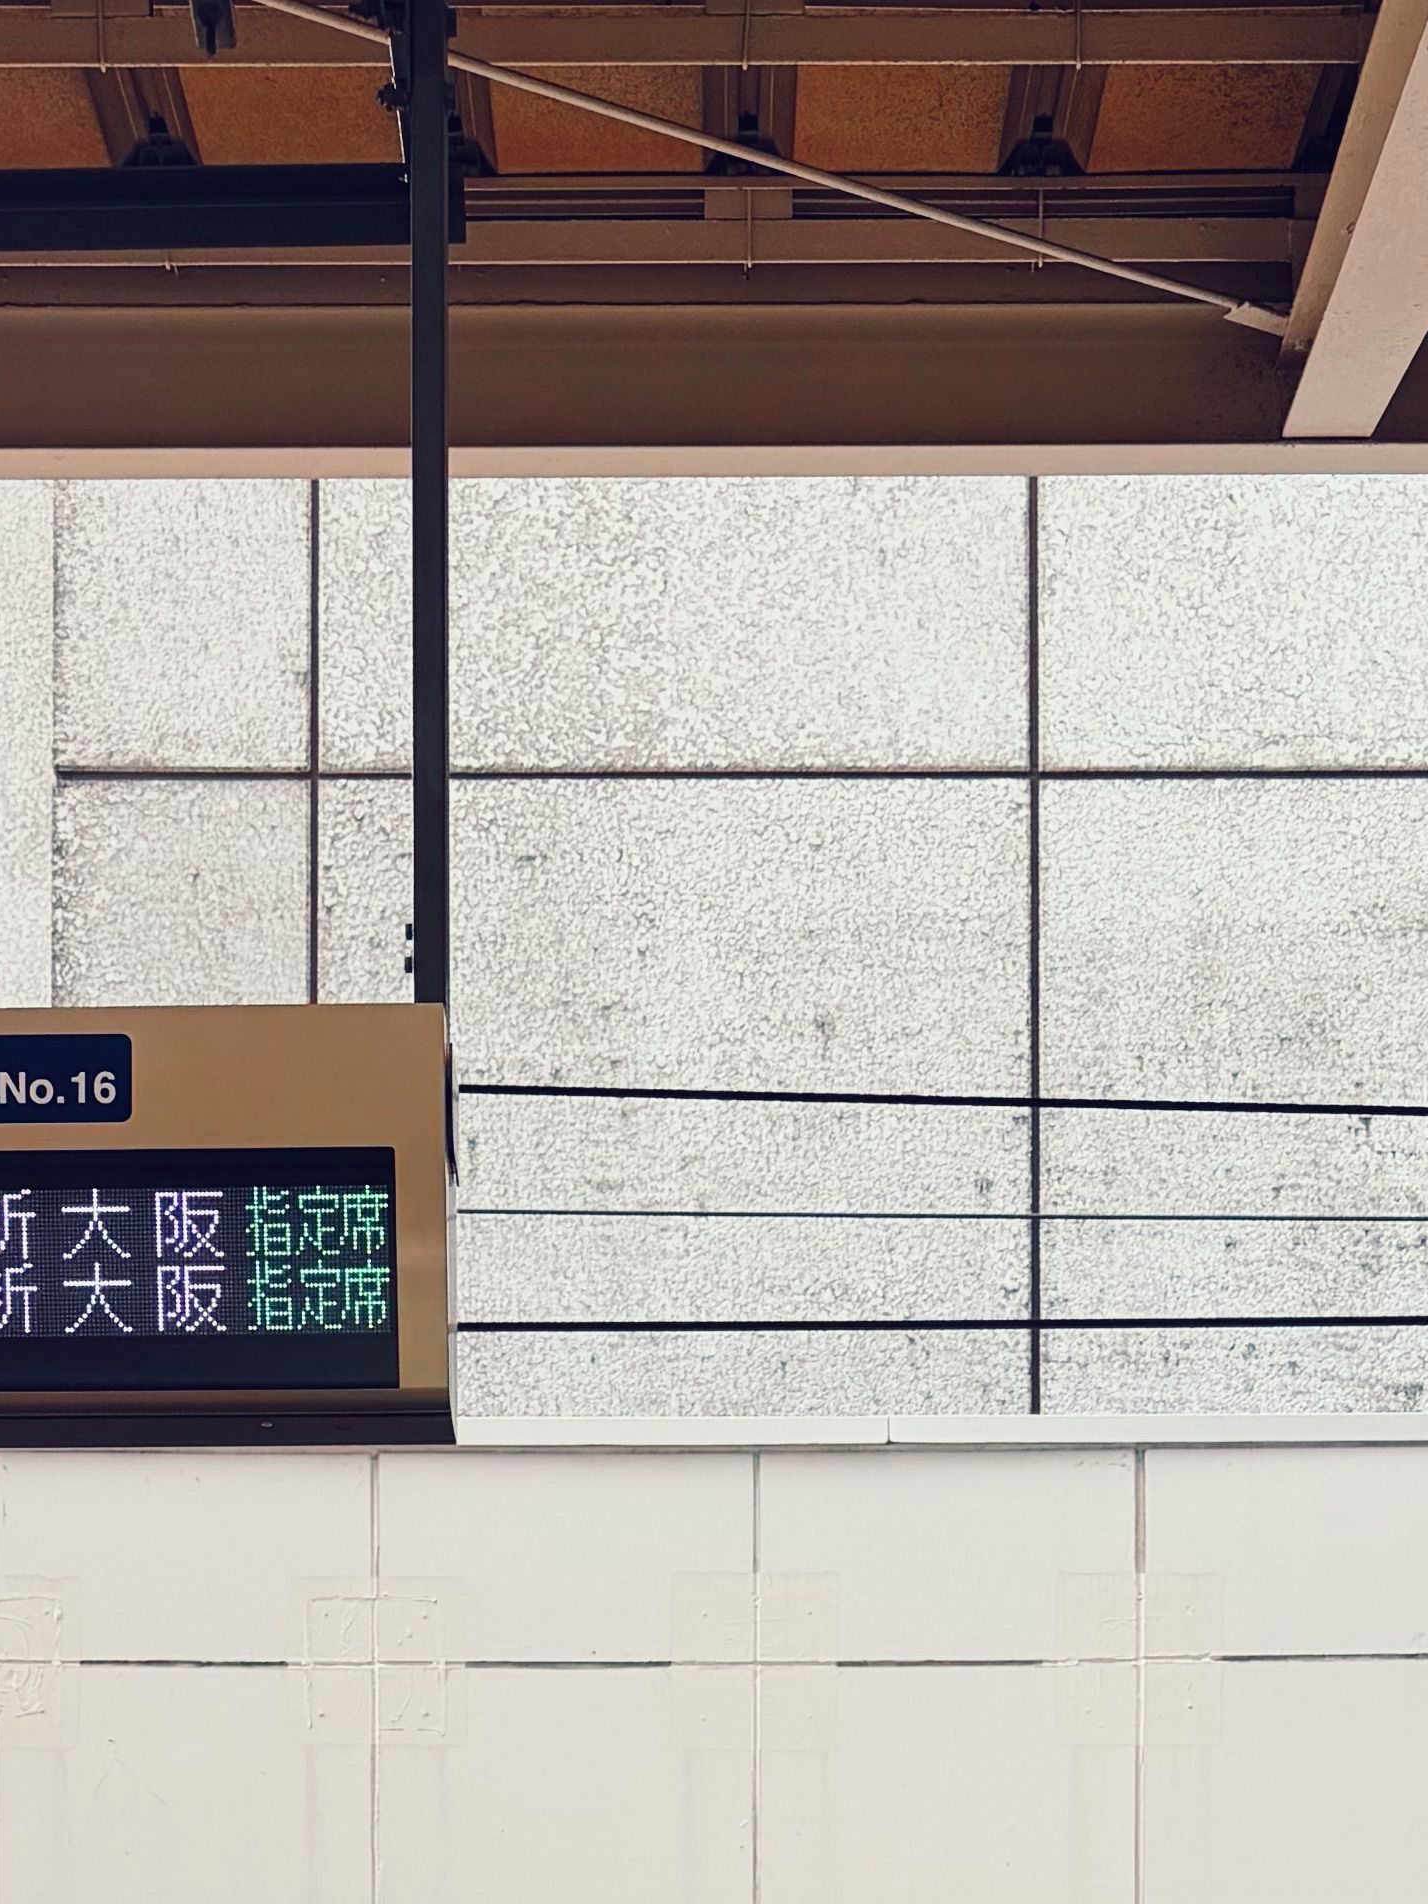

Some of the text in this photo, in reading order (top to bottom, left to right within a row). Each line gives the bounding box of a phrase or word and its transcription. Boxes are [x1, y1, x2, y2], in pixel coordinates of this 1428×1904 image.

[245, 1184, 390, 1258] 指定席
[247, 1262, 390, 1332] 指定席
